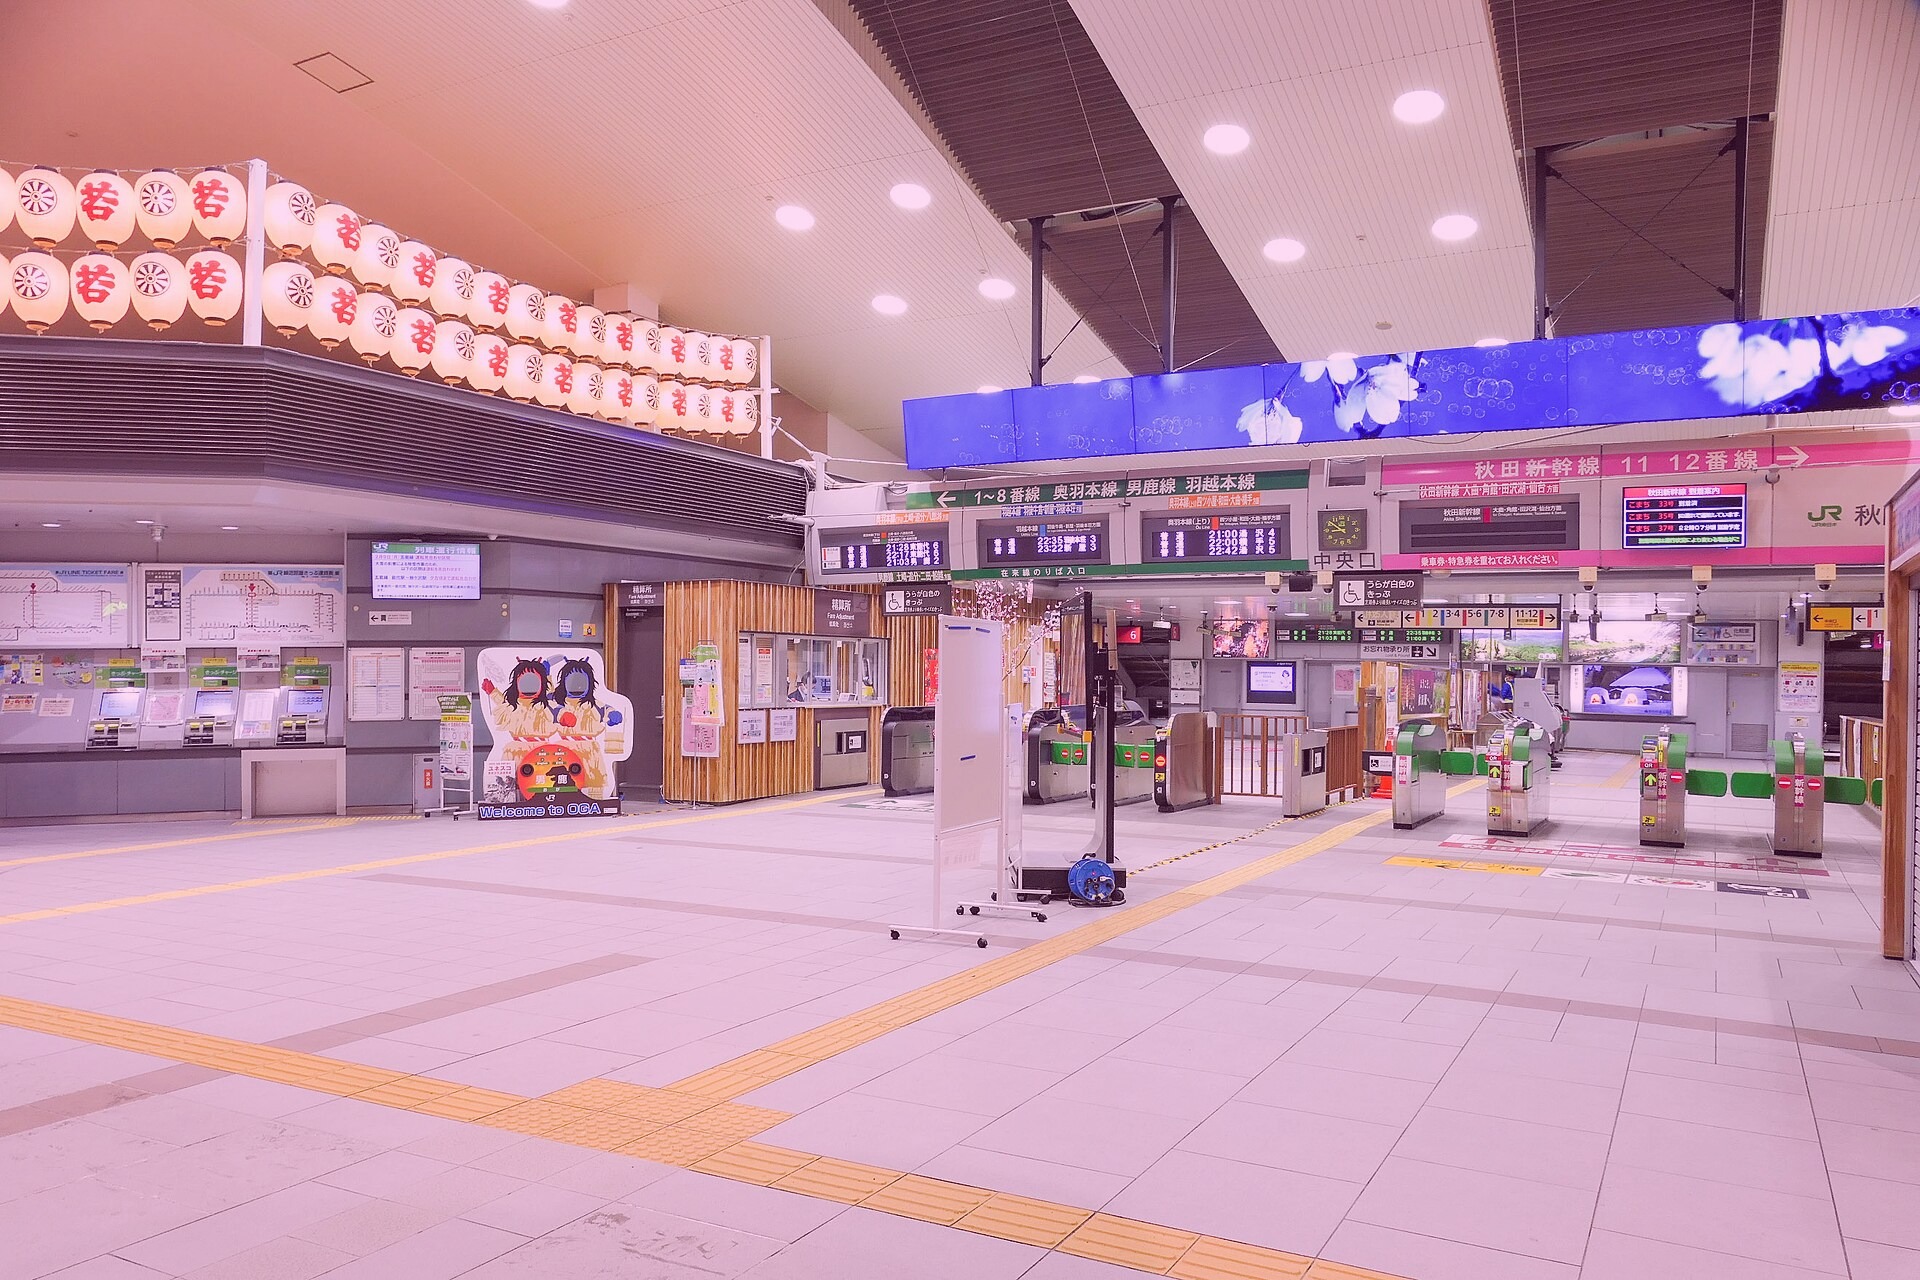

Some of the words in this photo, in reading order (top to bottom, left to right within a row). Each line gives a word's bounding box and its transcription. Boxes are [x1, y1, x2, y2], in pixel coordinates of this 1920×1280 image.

[80, 182, 118, 221] 若
[192, 179, 228, 219] 若
[337, 213, 360, 251] 若
[413, 251, 437, 287] 若
[76, 264, 115, 304] 若
[190, 261, 226, 299] 若
[488, 281, 510, 314] 若
[332, 287, 357, 325] 若
[559, 303, 577, 333] 若
[411, 319, 437, 354] 若
[616, 322, 632, 352] 若
[488, 346, 509, 378] 若
[554, 362, 573, 394] 若
[618, 377, 633, 407] 若
[1475, 456, 1600, 480] 秋田新幹線
[1621, 455, 1648, 473] 11
[1670, 449, 1758, 471] 12番線
[1053, 480, 1118, 501] 奥羽本線
[1126, 477, 1176, 497] 男鹿線
[1186, 473, 1256, 494] 羽越本線
[1443, 508, 1481, 517] 秋田新幹線
[1628, 501, 1650, 509] こまち
[1658, 500, 1674, 508] 33号
[1628, 513, 1650, 521] こまち
[1658, 512, 1674, 520] 35号
[1808, 505, 1842, 521] JR
[1854, 504, 1886, 527] 秋
[1208, 530, 1238, 538] 21:00
[1268, 528, 1275, 536] 4
[1628, 525, 1650, 533] こまち
[1658, 524, 1674, 532] 37号
[886, 543, 909, 551] 21:28
[933, 541, 940, 549] 6
[1038, 536, 1063, 545] 22:35
[1090, 535, 1097, 543] 3
[1038, 545, 1063, 553] 23:22
[1090, 543, 1097, 551] 3
[1208, 538, 1238, 547] 22:00
[1268, 537, 1275, 545] 5
[1208, 546, 1238, 555] 22:42
[1268, 545, 1275, 554] 5
[886, 558, 909, 566] 21:03
[1314, 552, 1376, 570] 中央口
[1001, 567, 1086, 578] 在来線のりば入口
[1367, 579, 1415, 590] うらが白色の
[905, 590, 940, 598] うらが白色の
[1367, 590, 1391, 598] きっぷ
[831, 598, 852, 612] 精算所
[836, 613, 855, 621] Adjustment
[1873, 609, 1879, 618] 1
[1130, 630, 1137, 640] 6
[1363, 645, 1410, 653] お忘れ物承り所
[1658, 771, 1667, 797] 新幹線
[1794, 778, 1804, 804] 新幹線
[546, 794, 556, 802] JR
[479, 805, 545, 819] Welcome
[548, 804, 564, 816] to
[567, 802, 601, 815] OGA
